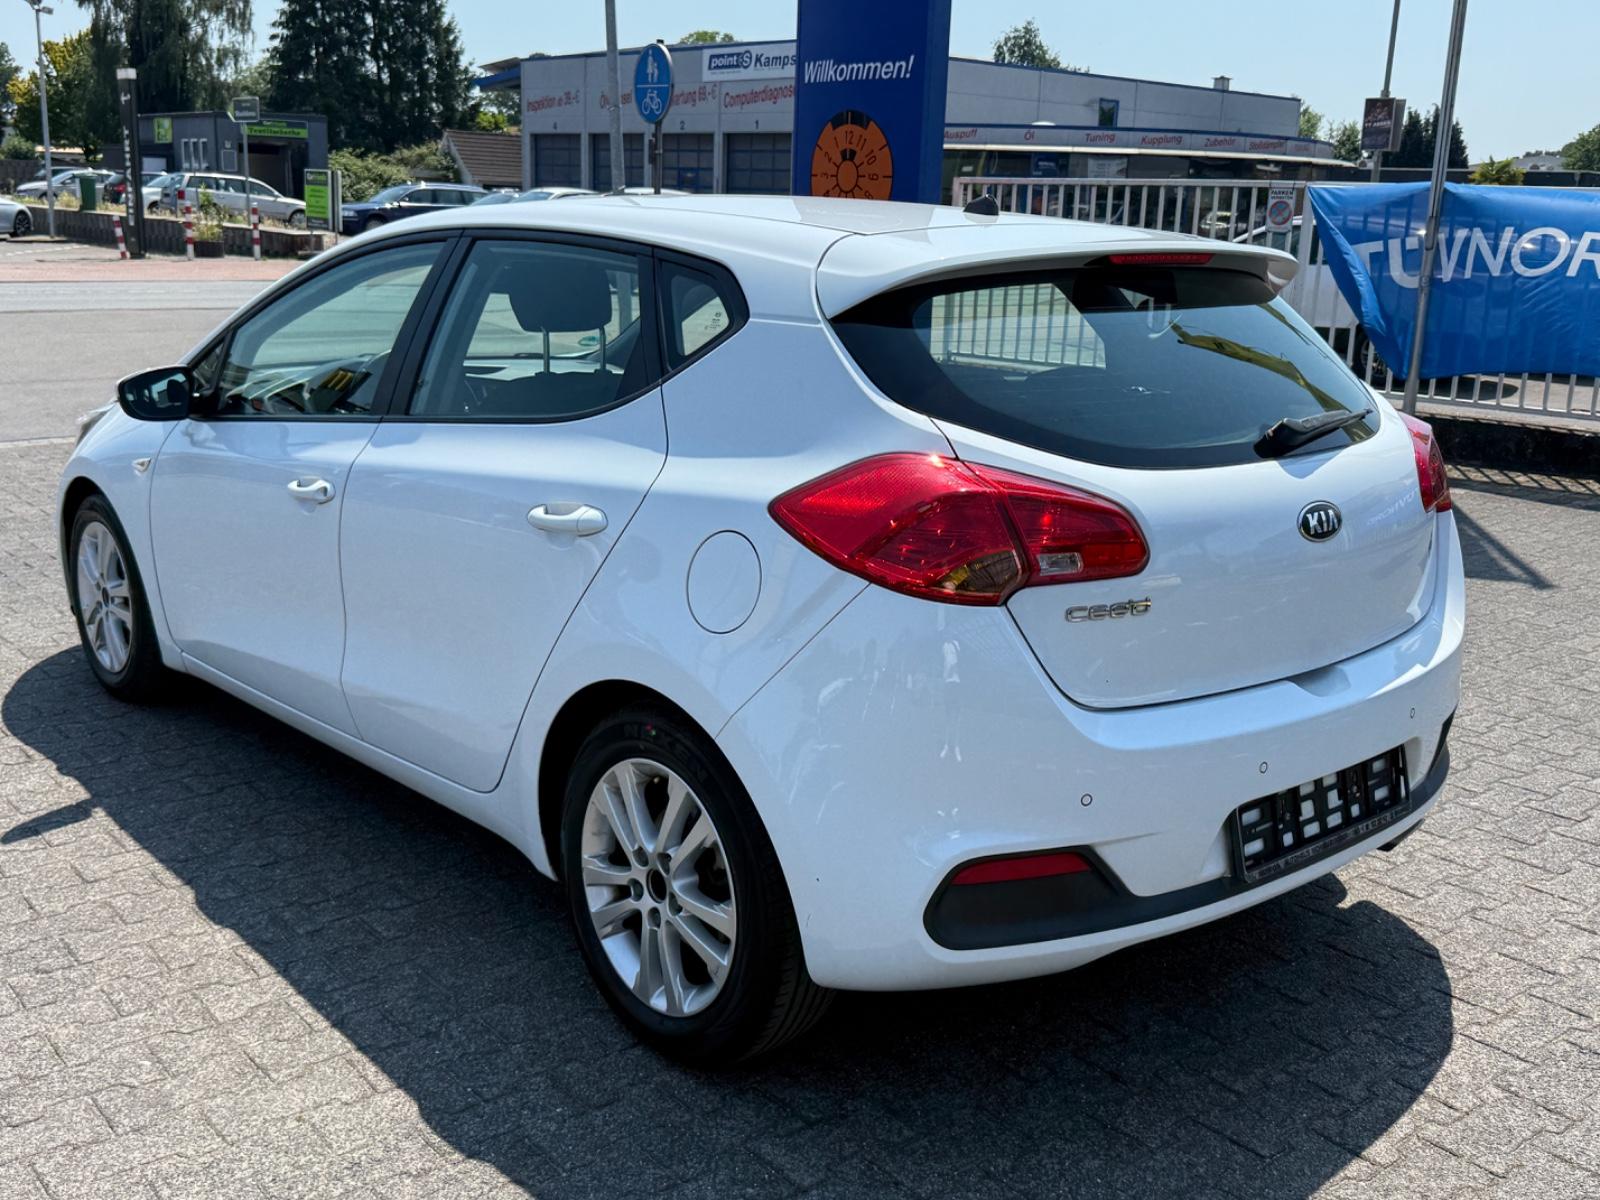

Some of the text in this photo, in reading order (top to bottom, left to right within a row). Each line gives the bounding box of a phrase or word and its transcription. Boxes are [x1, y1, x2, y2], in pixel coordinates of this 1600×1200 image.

[711, 56, 738, 69] point
[753, 54, 797, 69] Kamps
[804, 54, 915, 84] Willkommen!
[680, 120, 686, 130] 2
[754, 119, 760, 130] 1
[844, 130, 855, 146] 12
[944, 128, 978, 139] Auspuff
[1023, 130, 1036, 141] Öl
[1085, 132, 1116, 144] Tuning
[1140, 134, 1183, 146] Kupplung
[856, 133, 868, 152] 11
[1204, 137, 1237, 148] Zubehör
[823, 150, 833, 164] 2
[865, 148, 878, 167] 10
[1306, 509, 1339, 536] KIA
